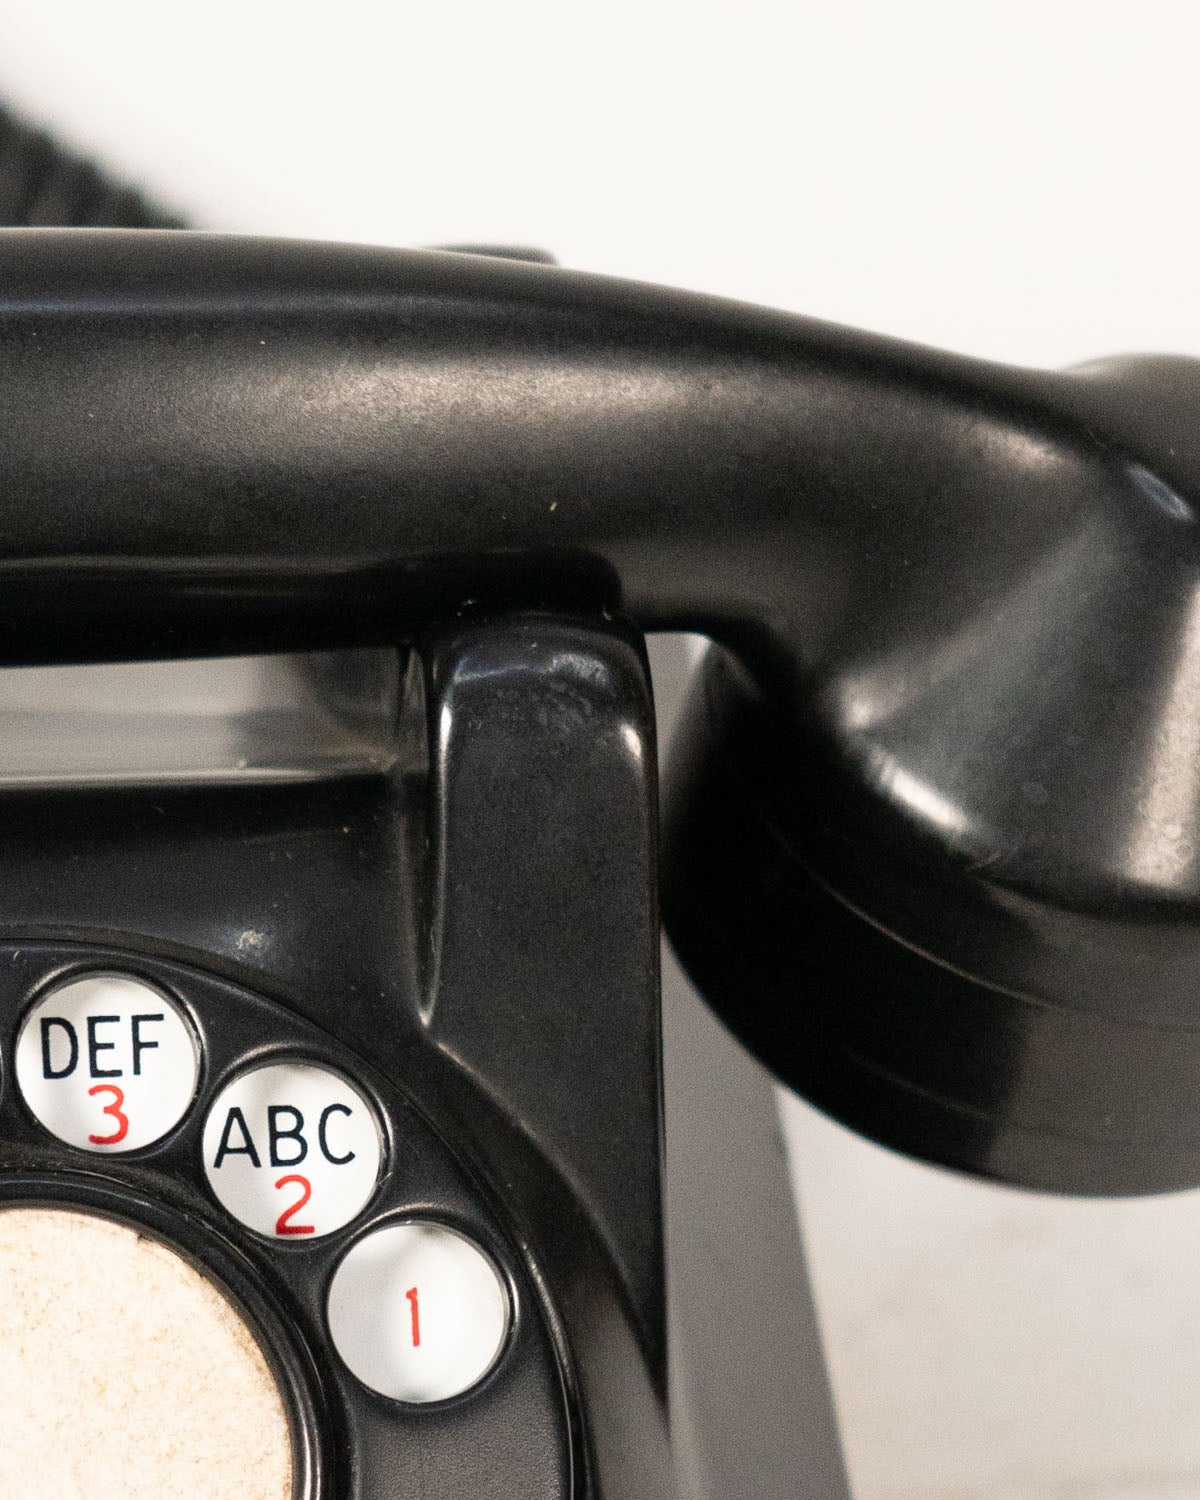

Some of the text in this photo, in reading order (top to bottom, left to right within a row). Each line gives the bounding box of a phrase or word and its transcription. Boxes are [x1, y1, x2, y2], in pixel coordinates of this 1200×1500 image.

[39, 1012, 165, 1080] DEF
[87, 1084, 130, 1146] 3
[212, 1102, 357, 1169] ABC
[274, 1174, 316, 1234] 2
[404, 1286, 421, 1348] 1
